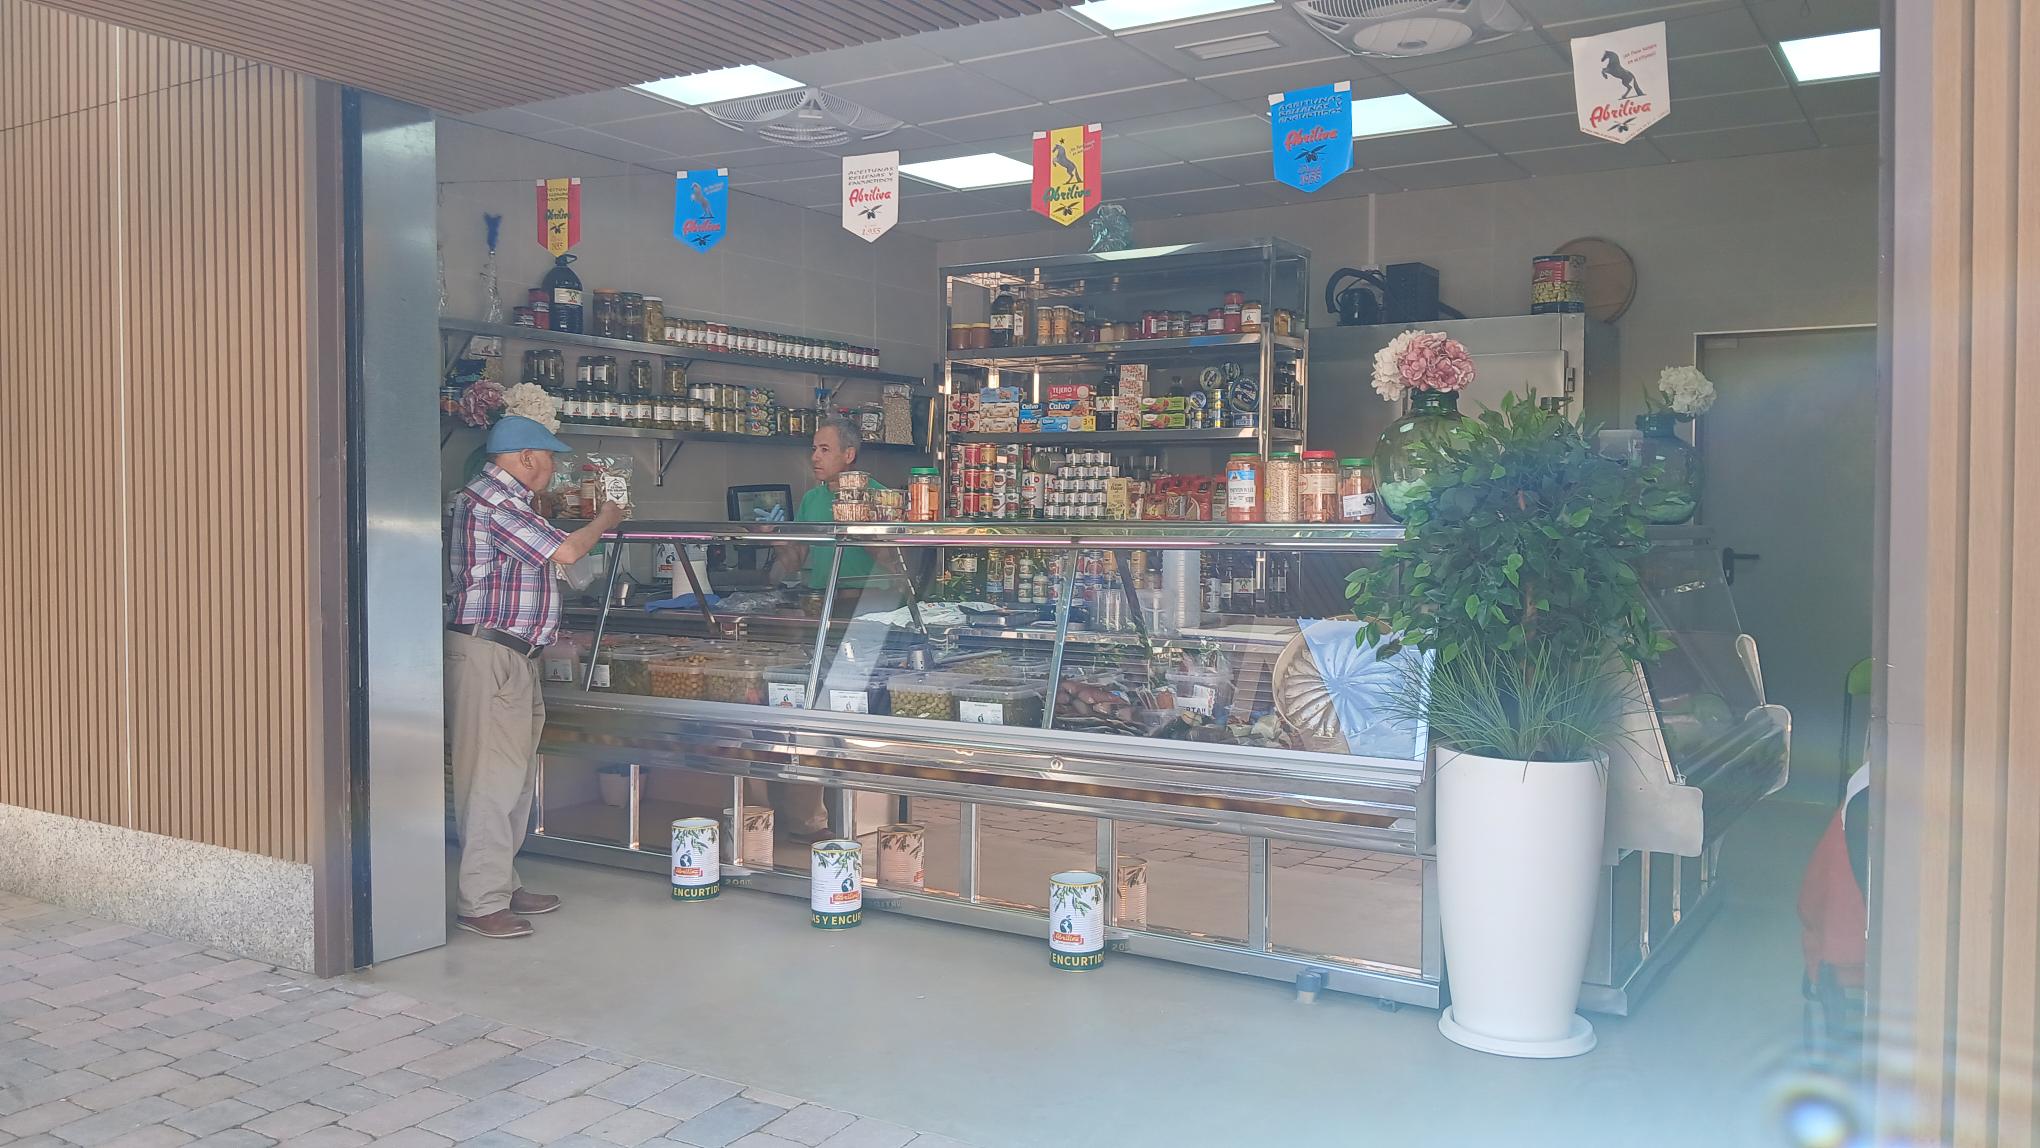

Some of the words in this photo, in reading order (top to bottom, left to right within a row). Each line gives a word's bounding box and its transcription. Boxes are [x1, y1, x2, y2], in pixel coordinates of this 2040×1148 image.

[1589, 100, 1652, 129] Abriliva
[848, 166, 895, 175] ACEITUNAS
[849, 186, 892, 208] Abriliva
[1048, 402, 1070, 410] Calvo
[822, 915, 829, 925] Y
